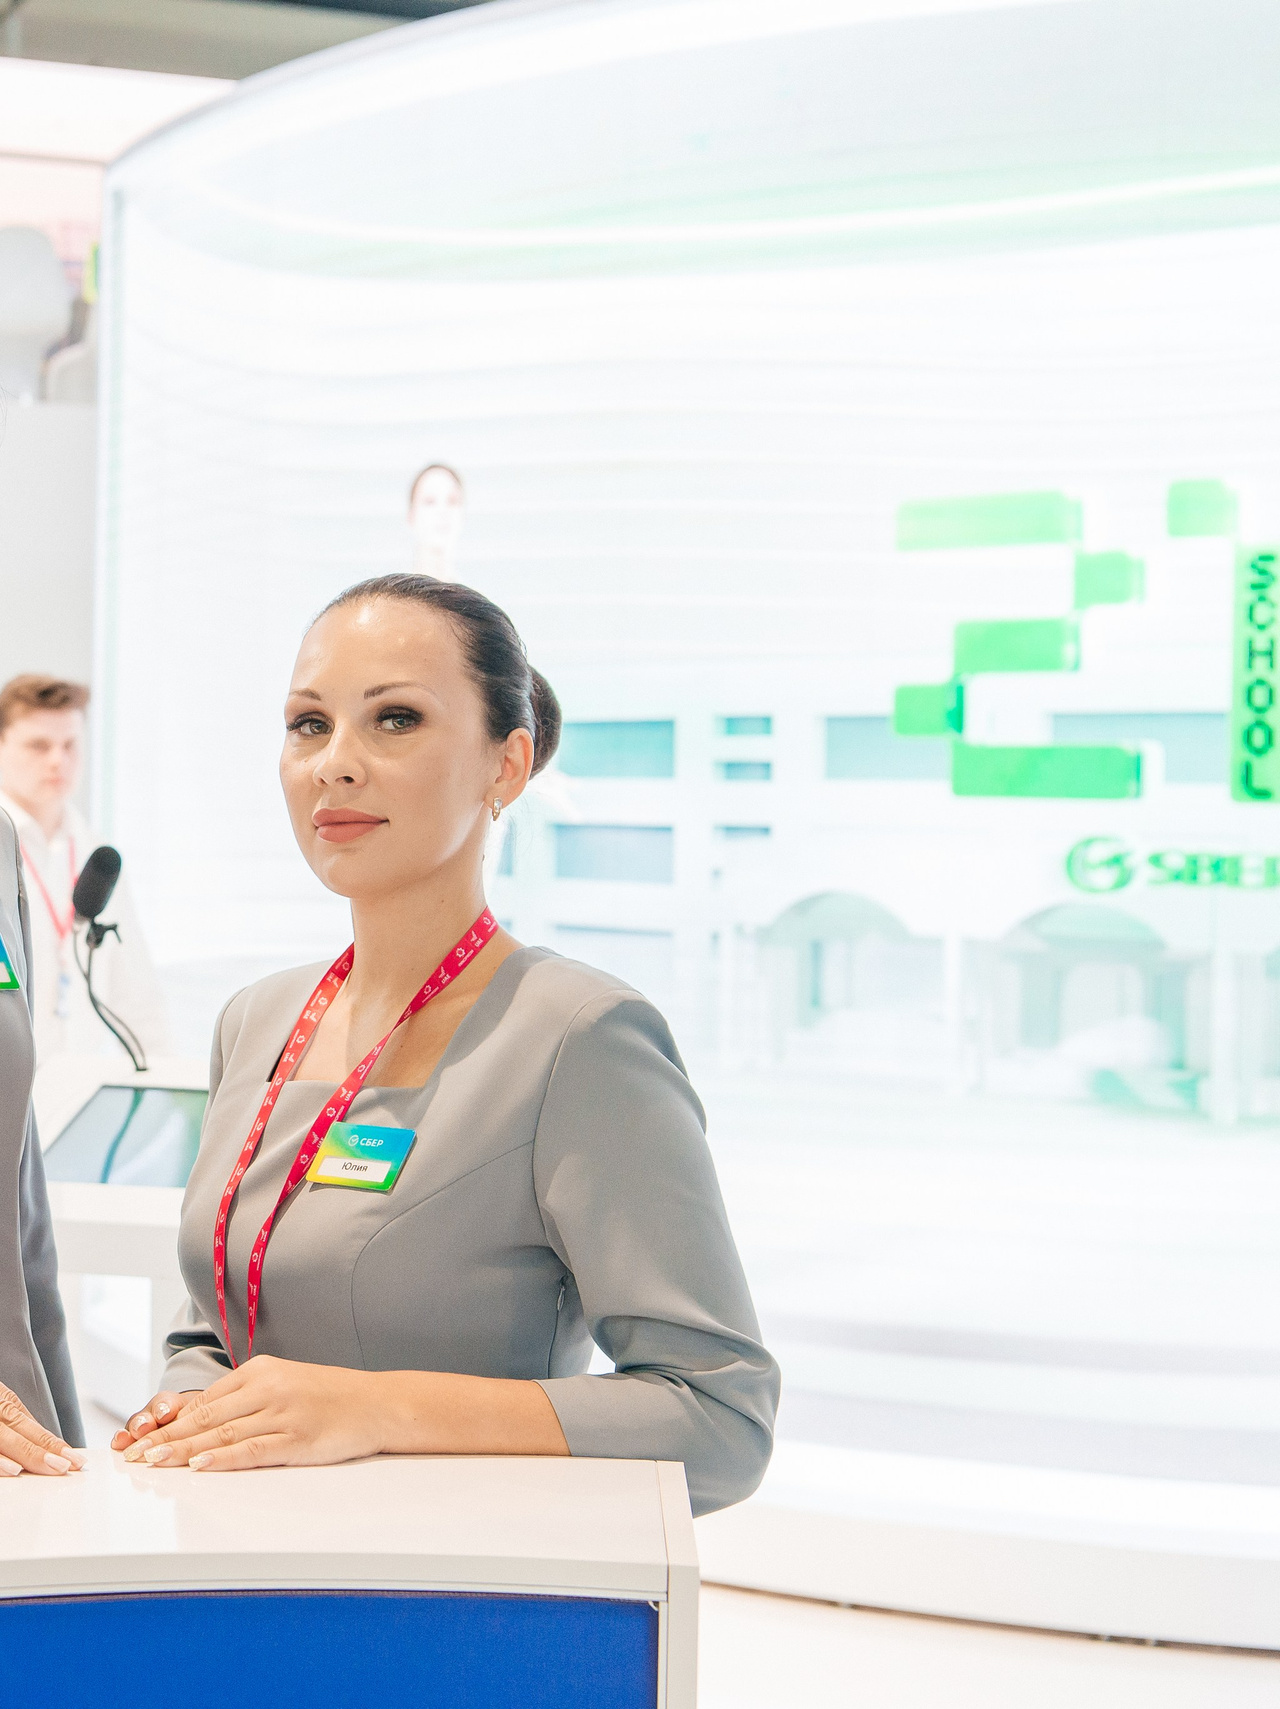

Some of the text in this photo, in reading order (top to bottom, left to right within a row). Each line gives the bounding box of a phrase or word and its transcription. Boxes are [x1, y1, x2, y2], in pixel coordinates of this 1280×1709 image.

[1241, 553, 1278, 800] SCHOOL
[359, 1137, 384, 1148] СБЕР
[341, 1161, 369, 1173] Юлия
